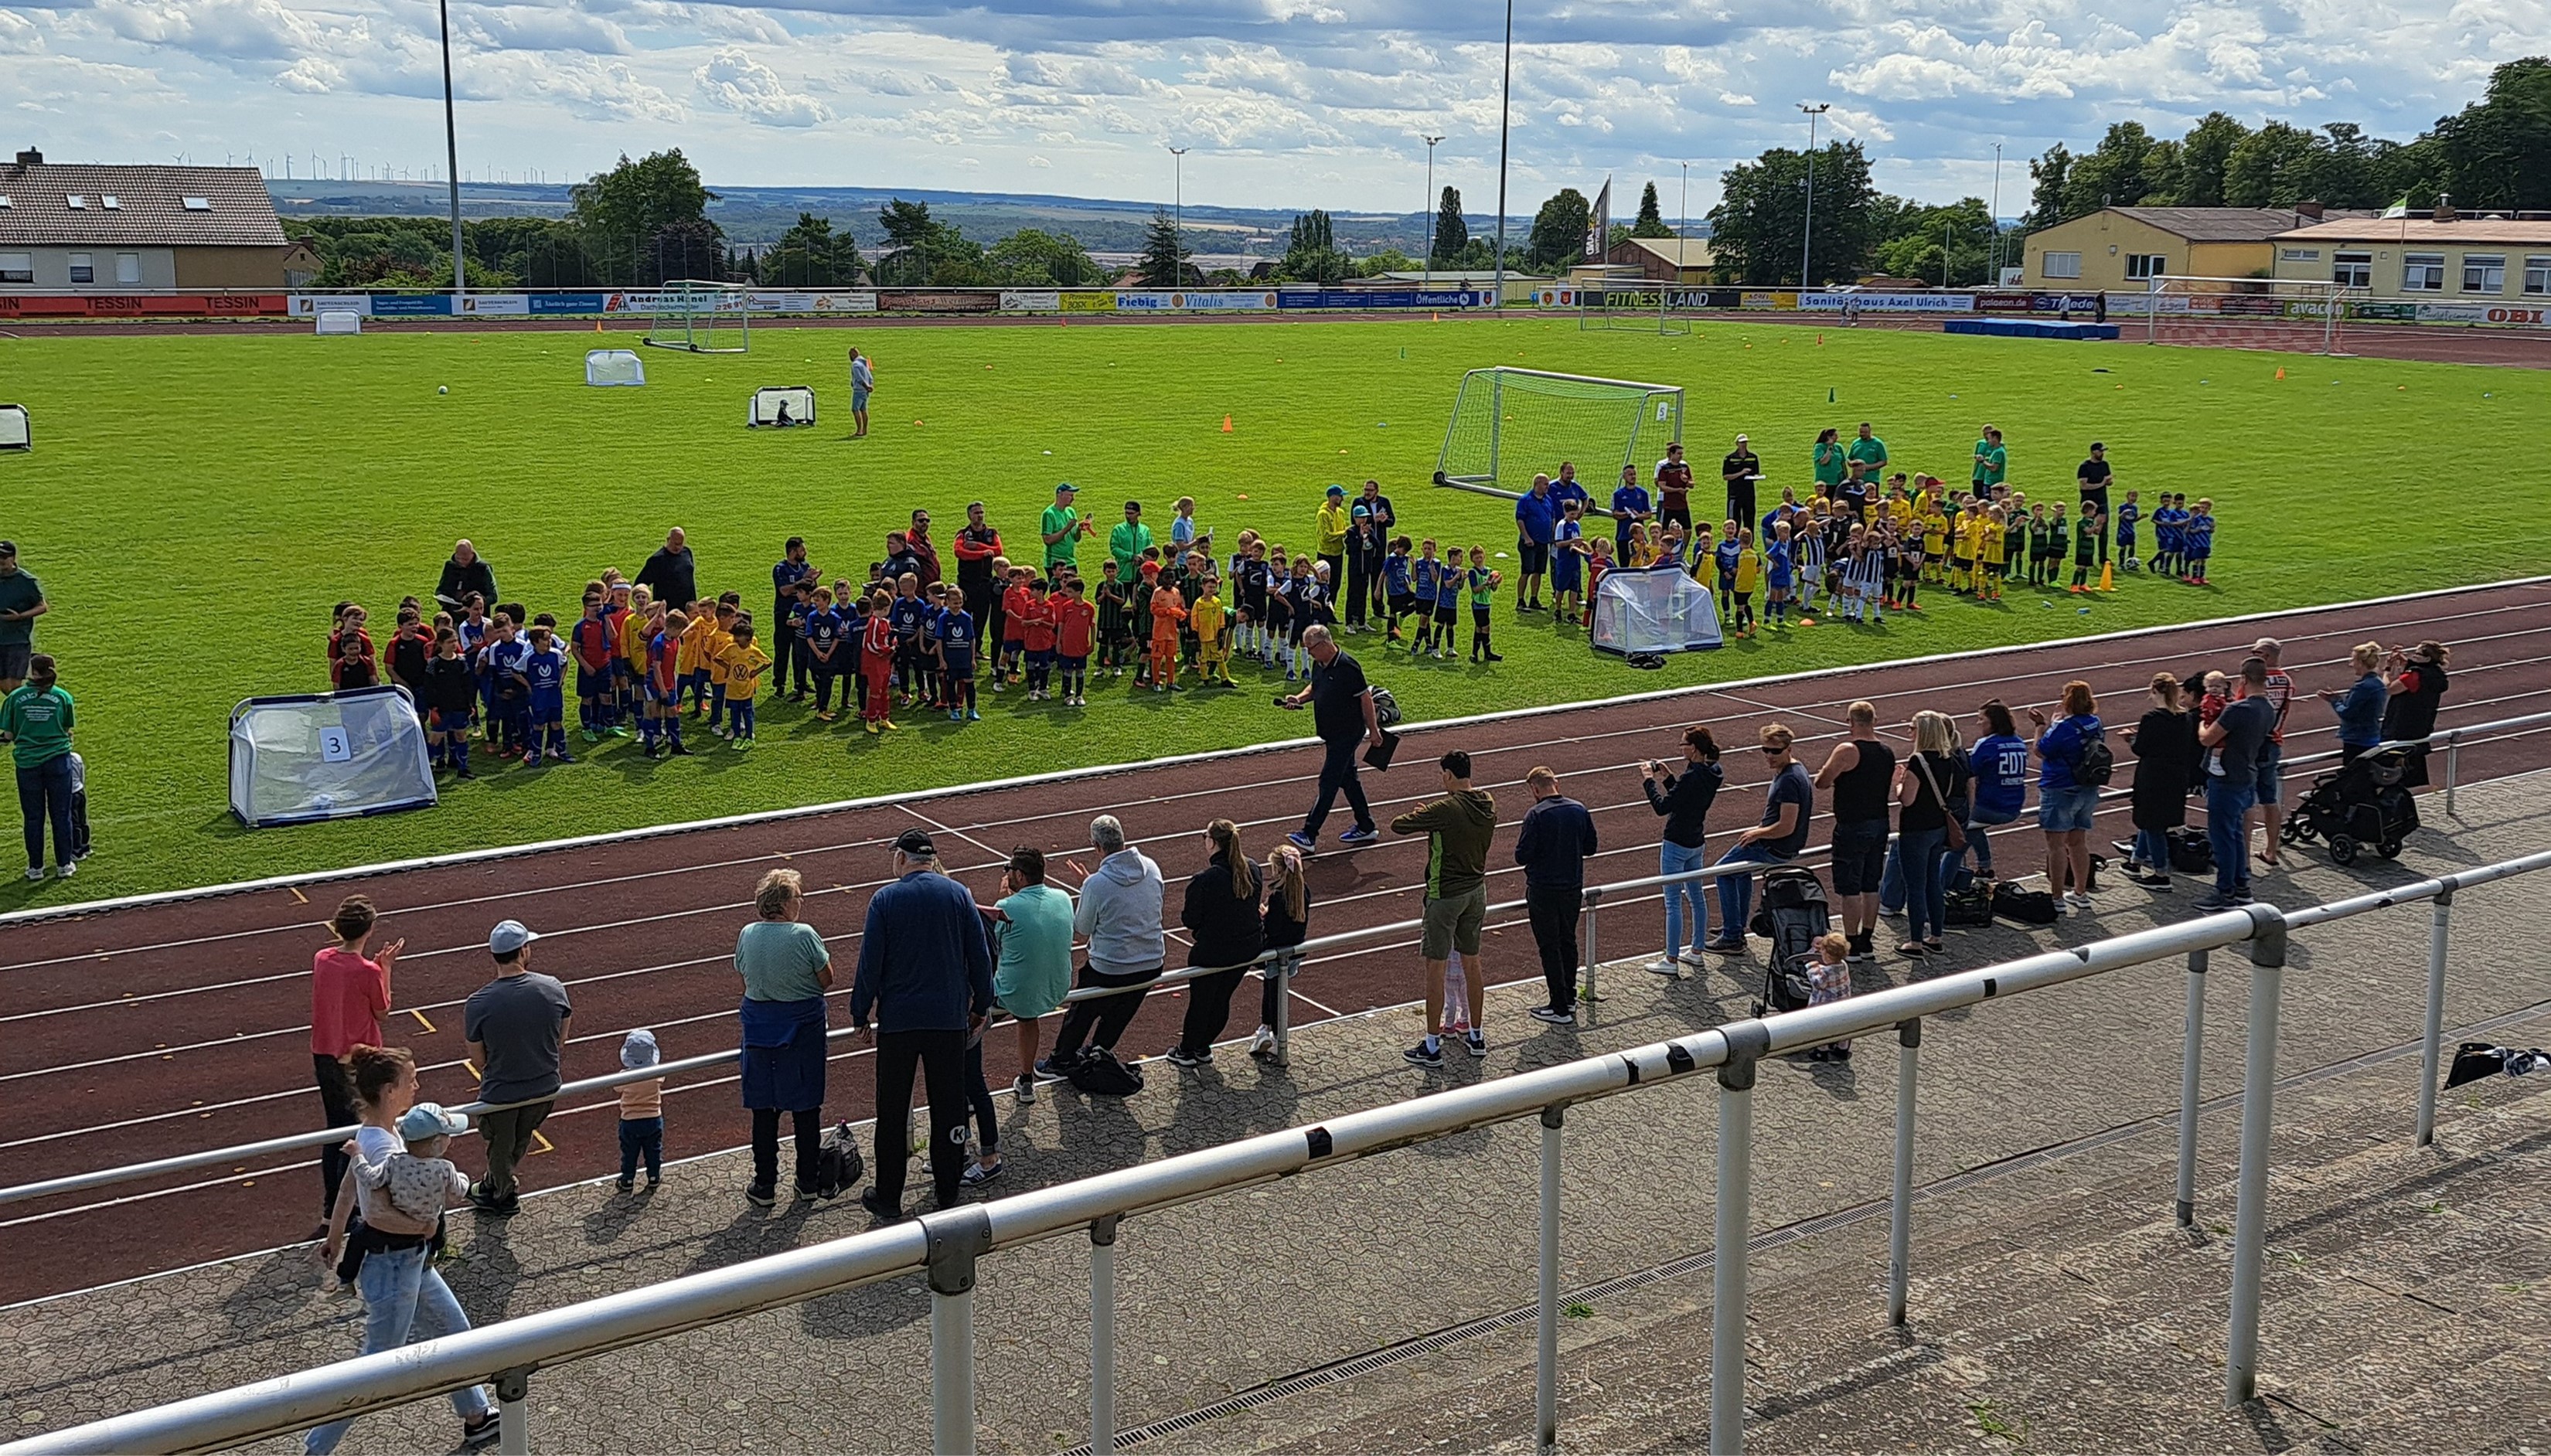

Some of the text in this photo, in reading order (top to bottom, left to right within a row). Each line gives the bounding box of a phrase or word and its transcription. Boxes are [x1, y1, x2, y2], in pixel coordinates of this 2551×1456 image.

[84, 297, 142, 309] TESSIN
[205, 297, 259, 309] TESSIN
[1117, 296, 1158, 308] Fiebig
[1184, 294, 1224, 308] Vitalis
[1415, 293, 1459, 304] Öffentliche
[1606, 291, 1709, 307] FITNESSLAND
[1888, 297, 1913, 307] Axel
[1916, 297, 1948, 307] Ulrich
[2487, 308, 2544, 324] OBI
[329, 737, 341, 754] 3
